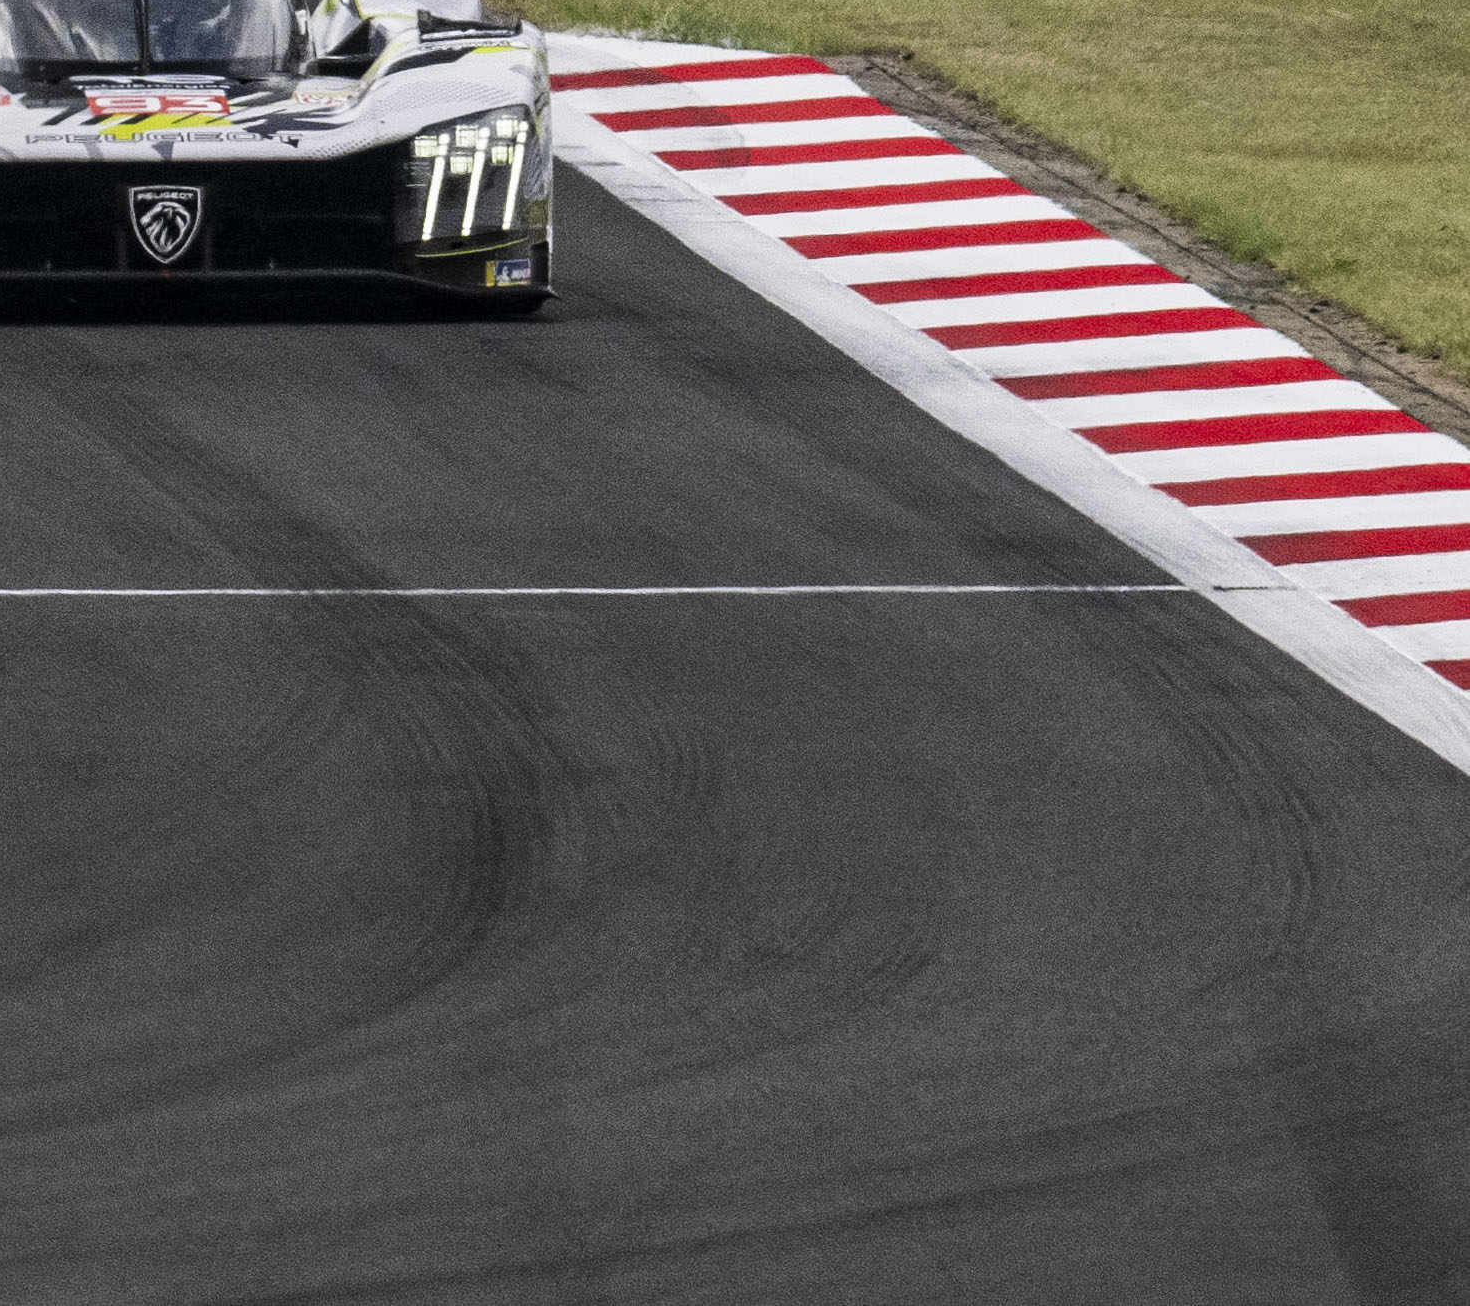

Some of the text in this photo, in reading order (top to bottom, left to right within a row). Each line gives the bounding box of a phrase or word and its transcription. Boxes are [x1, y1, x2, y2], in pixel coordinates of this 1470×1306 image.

[95, 96, 224, 115] 93
[25, 130, 304, 145] PEUGEOT
[136, 191, 195, 200] PEUGEOT
